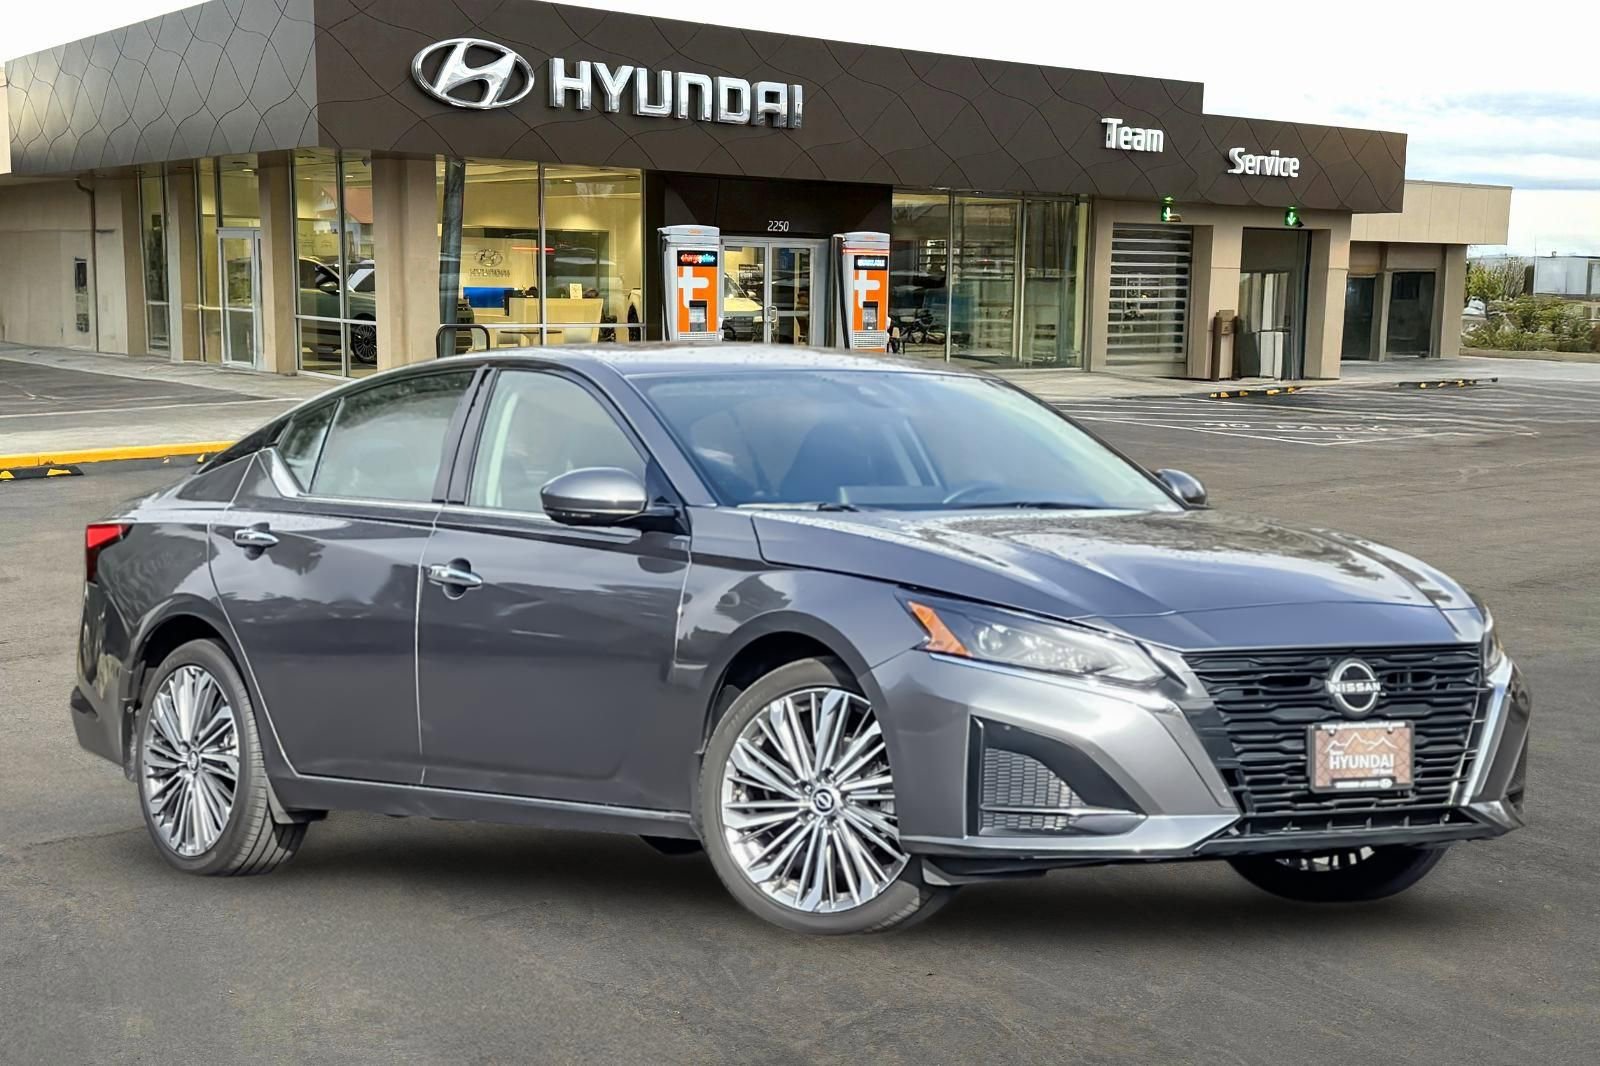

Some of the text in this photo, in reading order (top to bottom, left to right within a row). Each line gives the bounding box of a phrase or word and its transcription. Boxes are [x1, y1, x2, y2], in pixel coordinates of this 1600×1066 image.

[549, 57, 803, 129] HYUNDAI
[1101, 117, 1164, 152] Team
[1227, 147, 1300, 178] Service
[767, 220, 790, 232] 2250
[1327, 682, 1381, 693] NISSAN
[1329, 753, 1394, 770] HYUNDAI
